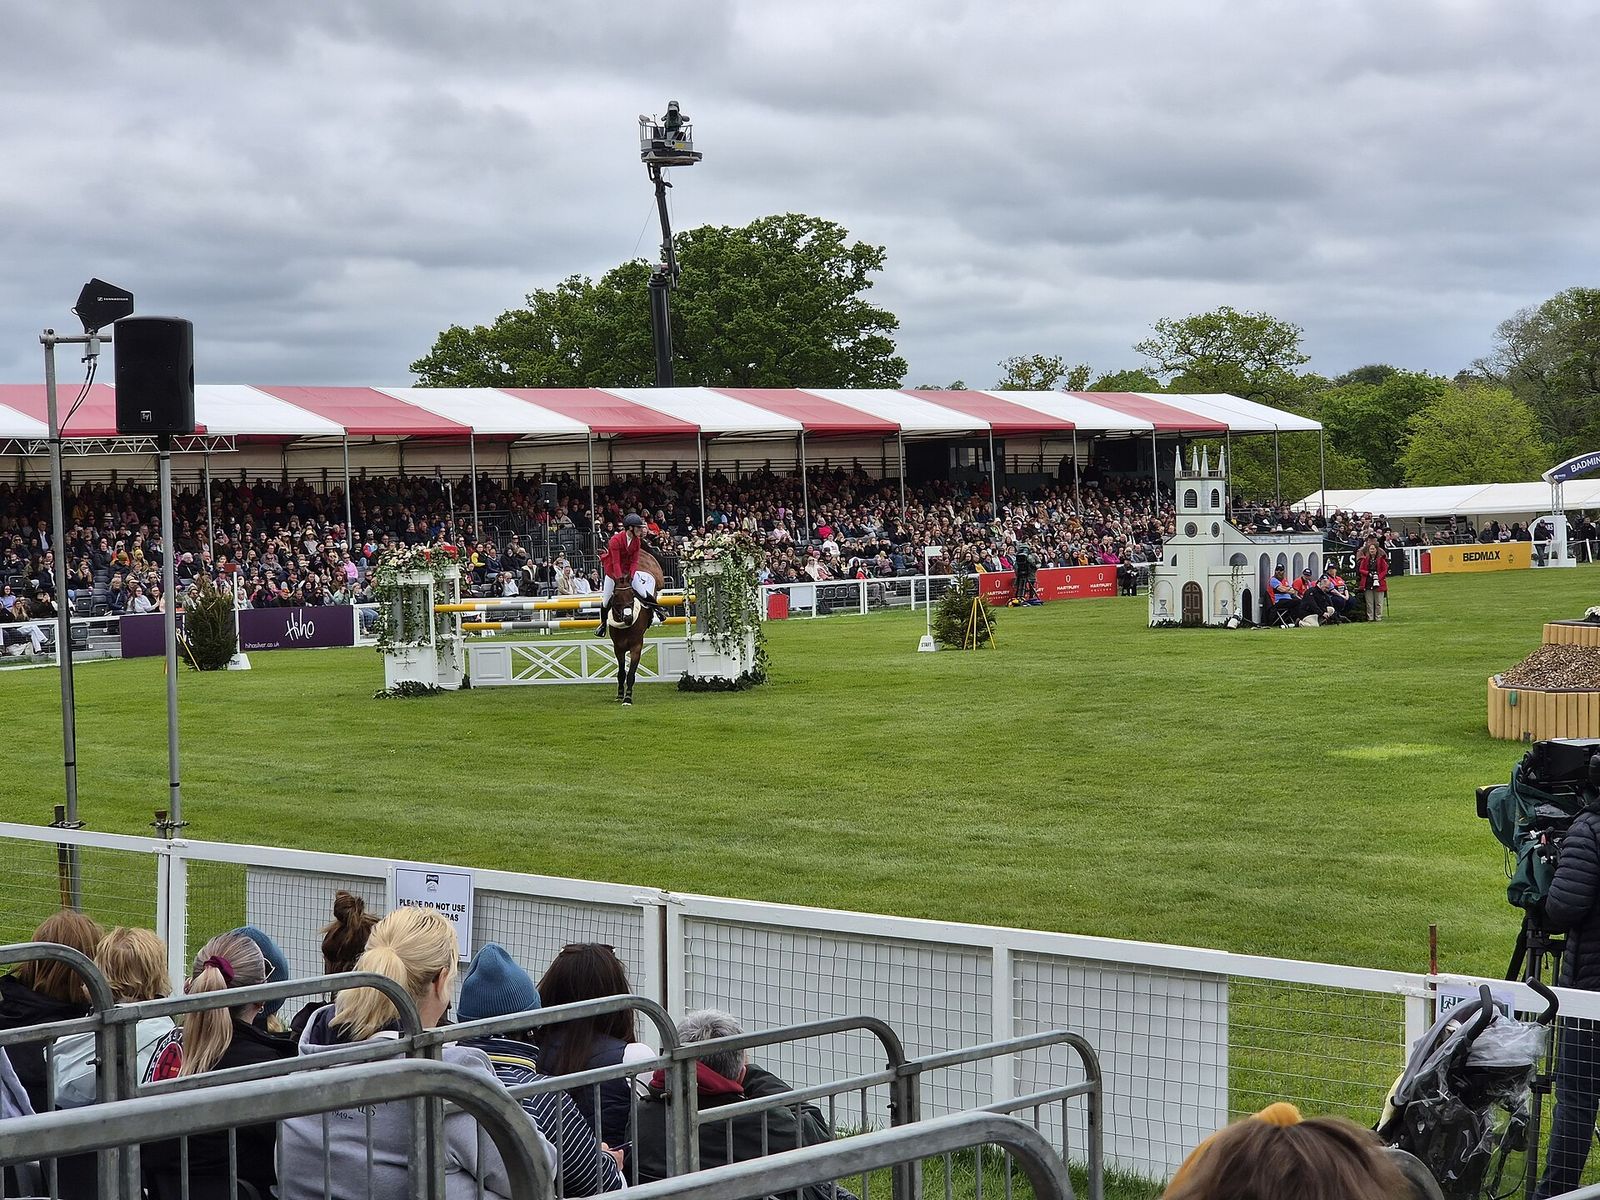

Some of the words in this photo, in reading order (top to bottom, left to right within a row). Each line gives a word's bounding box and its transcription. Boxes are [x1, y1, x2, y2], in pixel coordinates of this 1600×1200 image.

[1462, 550, 1501, 562] BEDMAX
[284, 608, 315, 641] Hiho
[435, 903, 451, 911] NOT
[451, 904, 466, 913] USE
